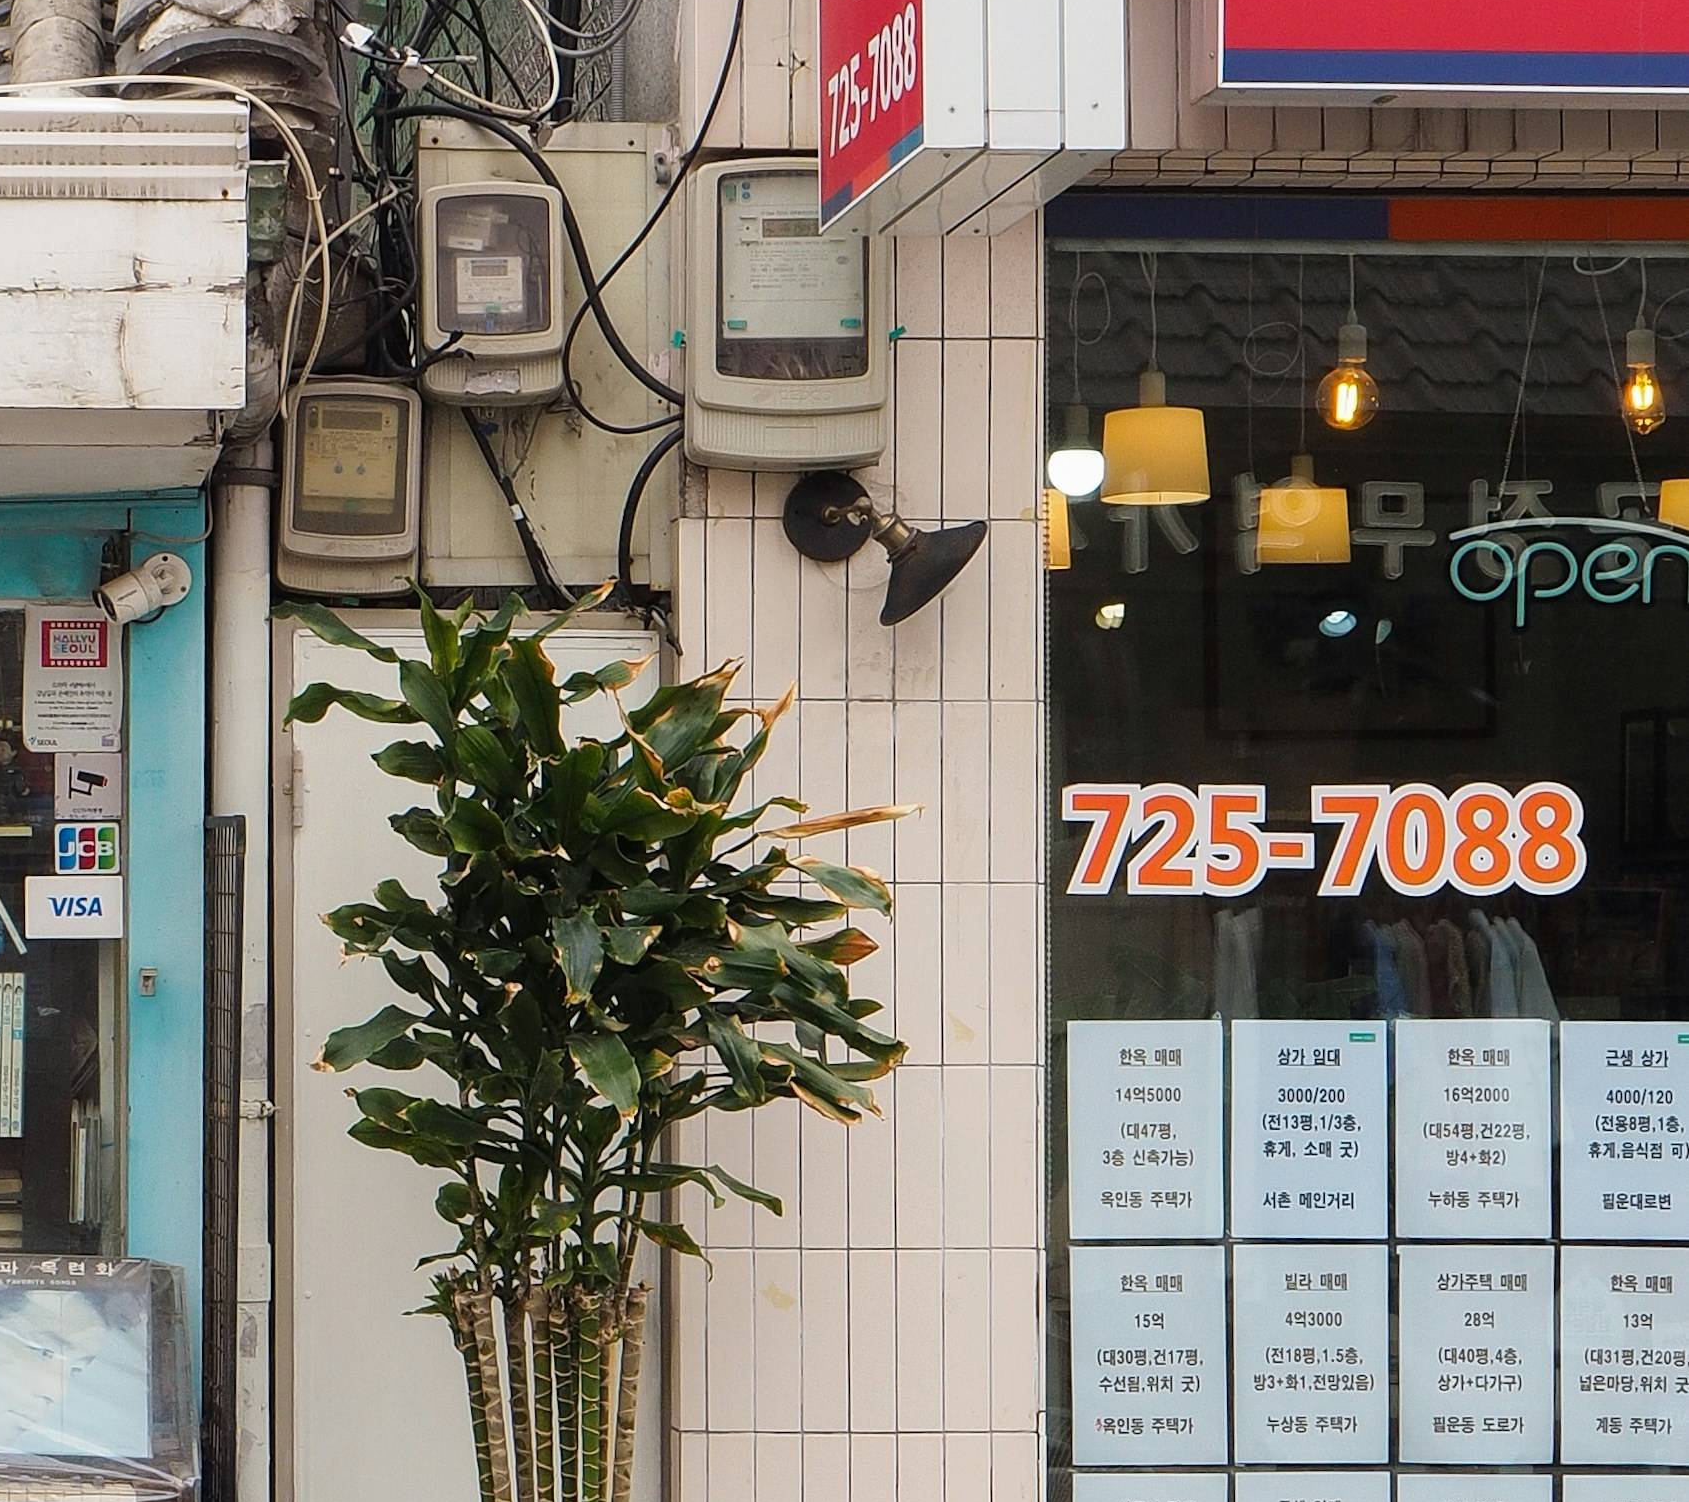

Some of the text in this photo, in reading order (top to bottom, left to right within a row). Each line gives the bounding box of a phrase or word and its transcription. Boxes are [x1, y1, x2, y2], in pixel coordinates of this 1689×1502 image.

[827, 1, 918, 160] 725-7088
[1449, 538, 1689, 627] open
[53, 634, 96, 644] HALLYU
[54, 643, 96, 654] SEOUL
[1062, 782, 1586, 897] 725-7088
[58, 840, 114, 858] JCB
[47, 897, 103, 917] VISA
[1120, 1049, 1181, 1066] 한옥 매매
[1278, 1049, 1340, 1066] 상가 임대
[1448, 1049, 1509, 1066] 한옥 매매
[1606, 1050, 1668, 1067] 근생 상가
[1116, 1087, 1181, 1103] 14억5000
[1279, 1087, 1344, 1103] 3000/200
[1444, 1087, 1509, 1103] 16억2000
[1607, 1089, 1672, 1105] 4000/120
[1121, 1123, 1176, 1139] (대47평,
[1263, 1114, 1361, 1131] (전13평,1/3층,
[1423, 1122, 1529, 1140] (대54평,건22평,
[1596, 1115, 1684, 1132] (전용8평,1층,
[1103, 1150, 1193, 1166] 3층 신축가능)
[1263, 1141, 1358, 1158] 휴게, 소매 굿)
[1447, 1150, 1505, 1166] 방4+화2)
[1589, 1142, 1662, 1159] 휴게,음식점
[1101, 1191, 1192, 1208] 옥인동 주택가
[1263, 1192, 1353, 1209] 서촌 메인거리
[1428, 1191, 1519, 1208] 누하동 주택가
[1603, 1193, 1671, 1210] 필운대로변
[1121, 1275, 1182, 1292] 한옥 매매
[1286, 1273, 1347, 1291] 빌라 매매
[1438, 1273, 1527, 1291] 상가주택 매매
[1611, 1275, 1672, 1293] 한옥 매매
[1135, 1313, 1163, 1329] 15억
[1286, 1311, 1342, 1328] 4억3000
[1465, 1311, 1494, 1328] 28억
[1624, 1314, 1652, 1330] 13억
[1098, 1349, 1203, 1366] (대30평,건17평,
[1266, 1347, 1362, 1364] (전18평,1.5층,
[1439, 1347, 1521, 1365] (대40평,4층,
[1099, 1376, 1199, 1393] 수선됨,위치 굿)
[1254, 1374, 1374, 1391] 방3+화1,전망있음)
[1438, 1375, 1521, 1391] 상가+다가구)
[1580, 1375, 1666, 1393] 넓은마당,위치
[1101, 1418, 1193, 1434] 옥인동 주택가
[1267, 1416, 1357, 1433] 누상동 주택가
[1433, 1417, 1524, 1434] 필운동 도로가
[1597, 1417, 1671, 1434] 계동 주택가
